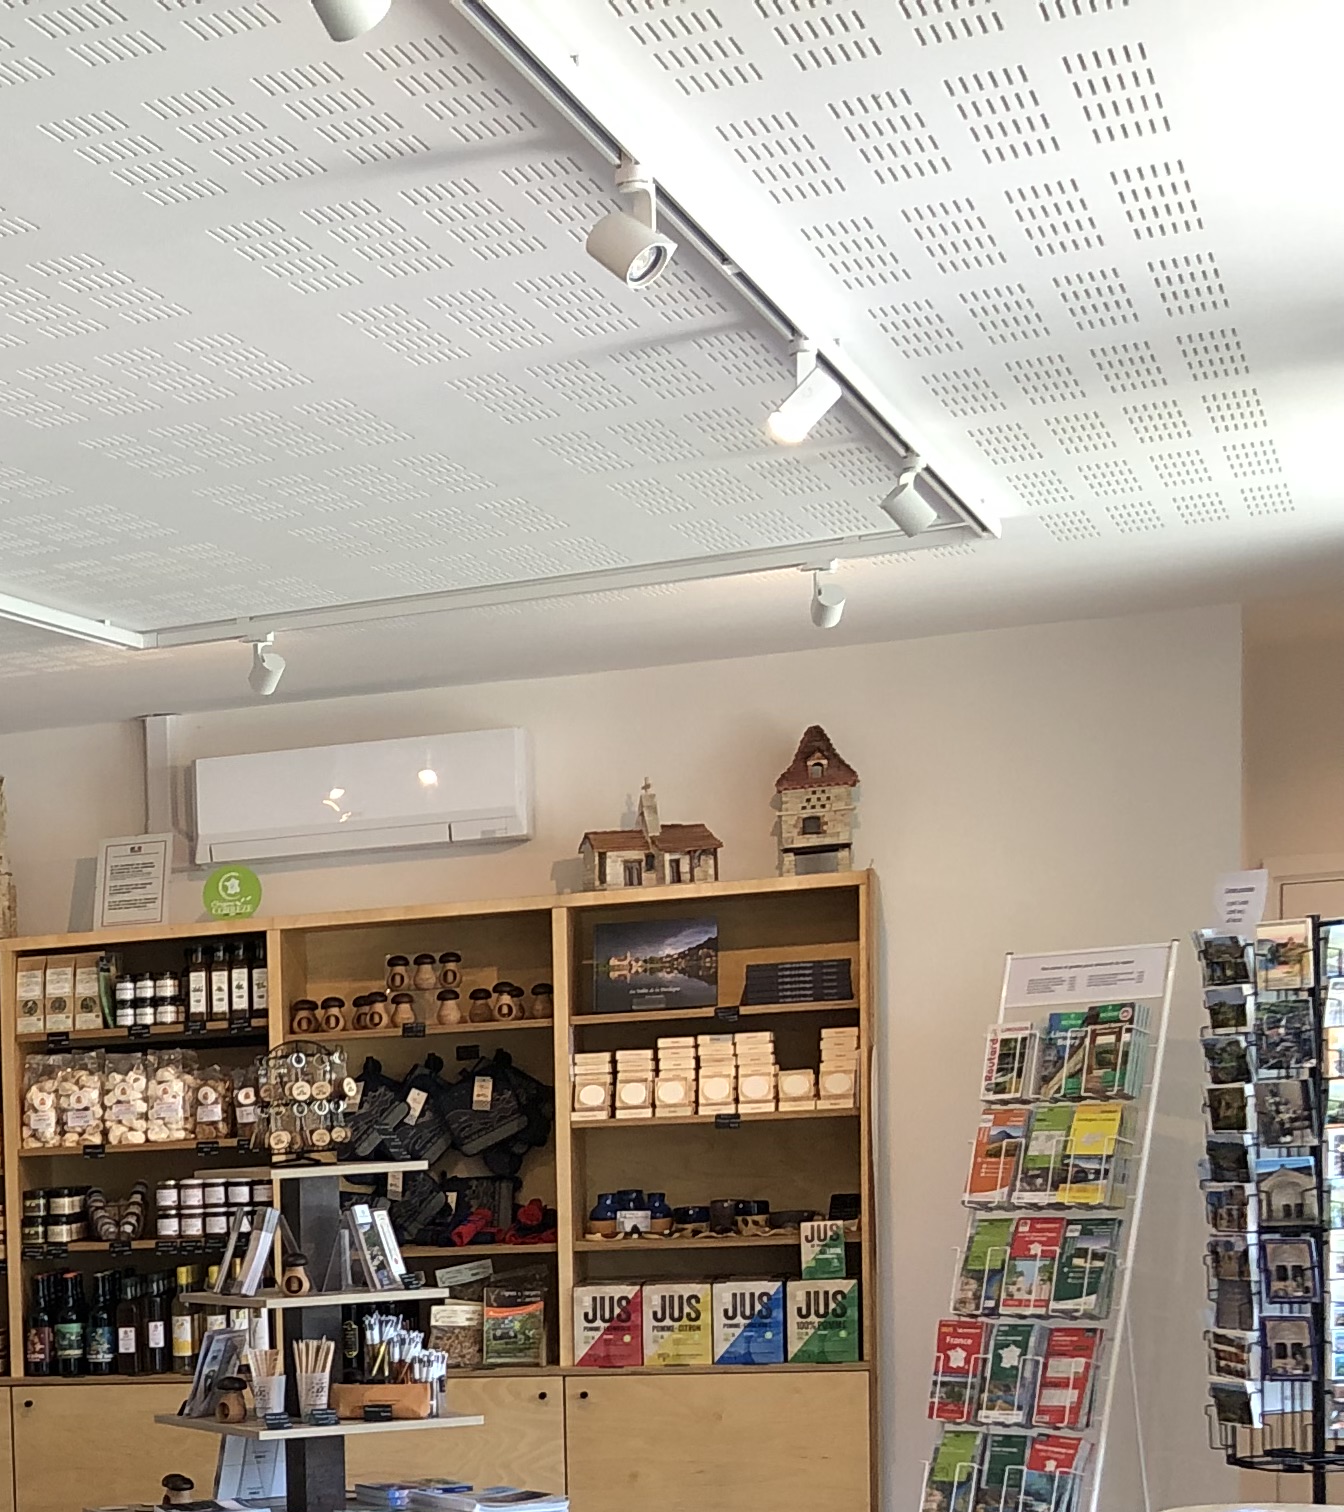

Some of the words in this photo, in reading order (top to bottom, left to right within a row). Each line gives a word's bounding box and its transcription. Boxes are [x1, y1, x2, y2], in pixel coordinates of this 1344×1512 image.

[984, 1037, 998, 1083] Routard
[804, 1223, 840, 1243] JUS
[583, 1295, 632, 1324] JUS
[652, 1294, 702, 1323] JUS
[722, 1292, 773, 1321] JUS
[796, 1289, 848, 1320] JUS
[945, 1336, 973, 1346] France
